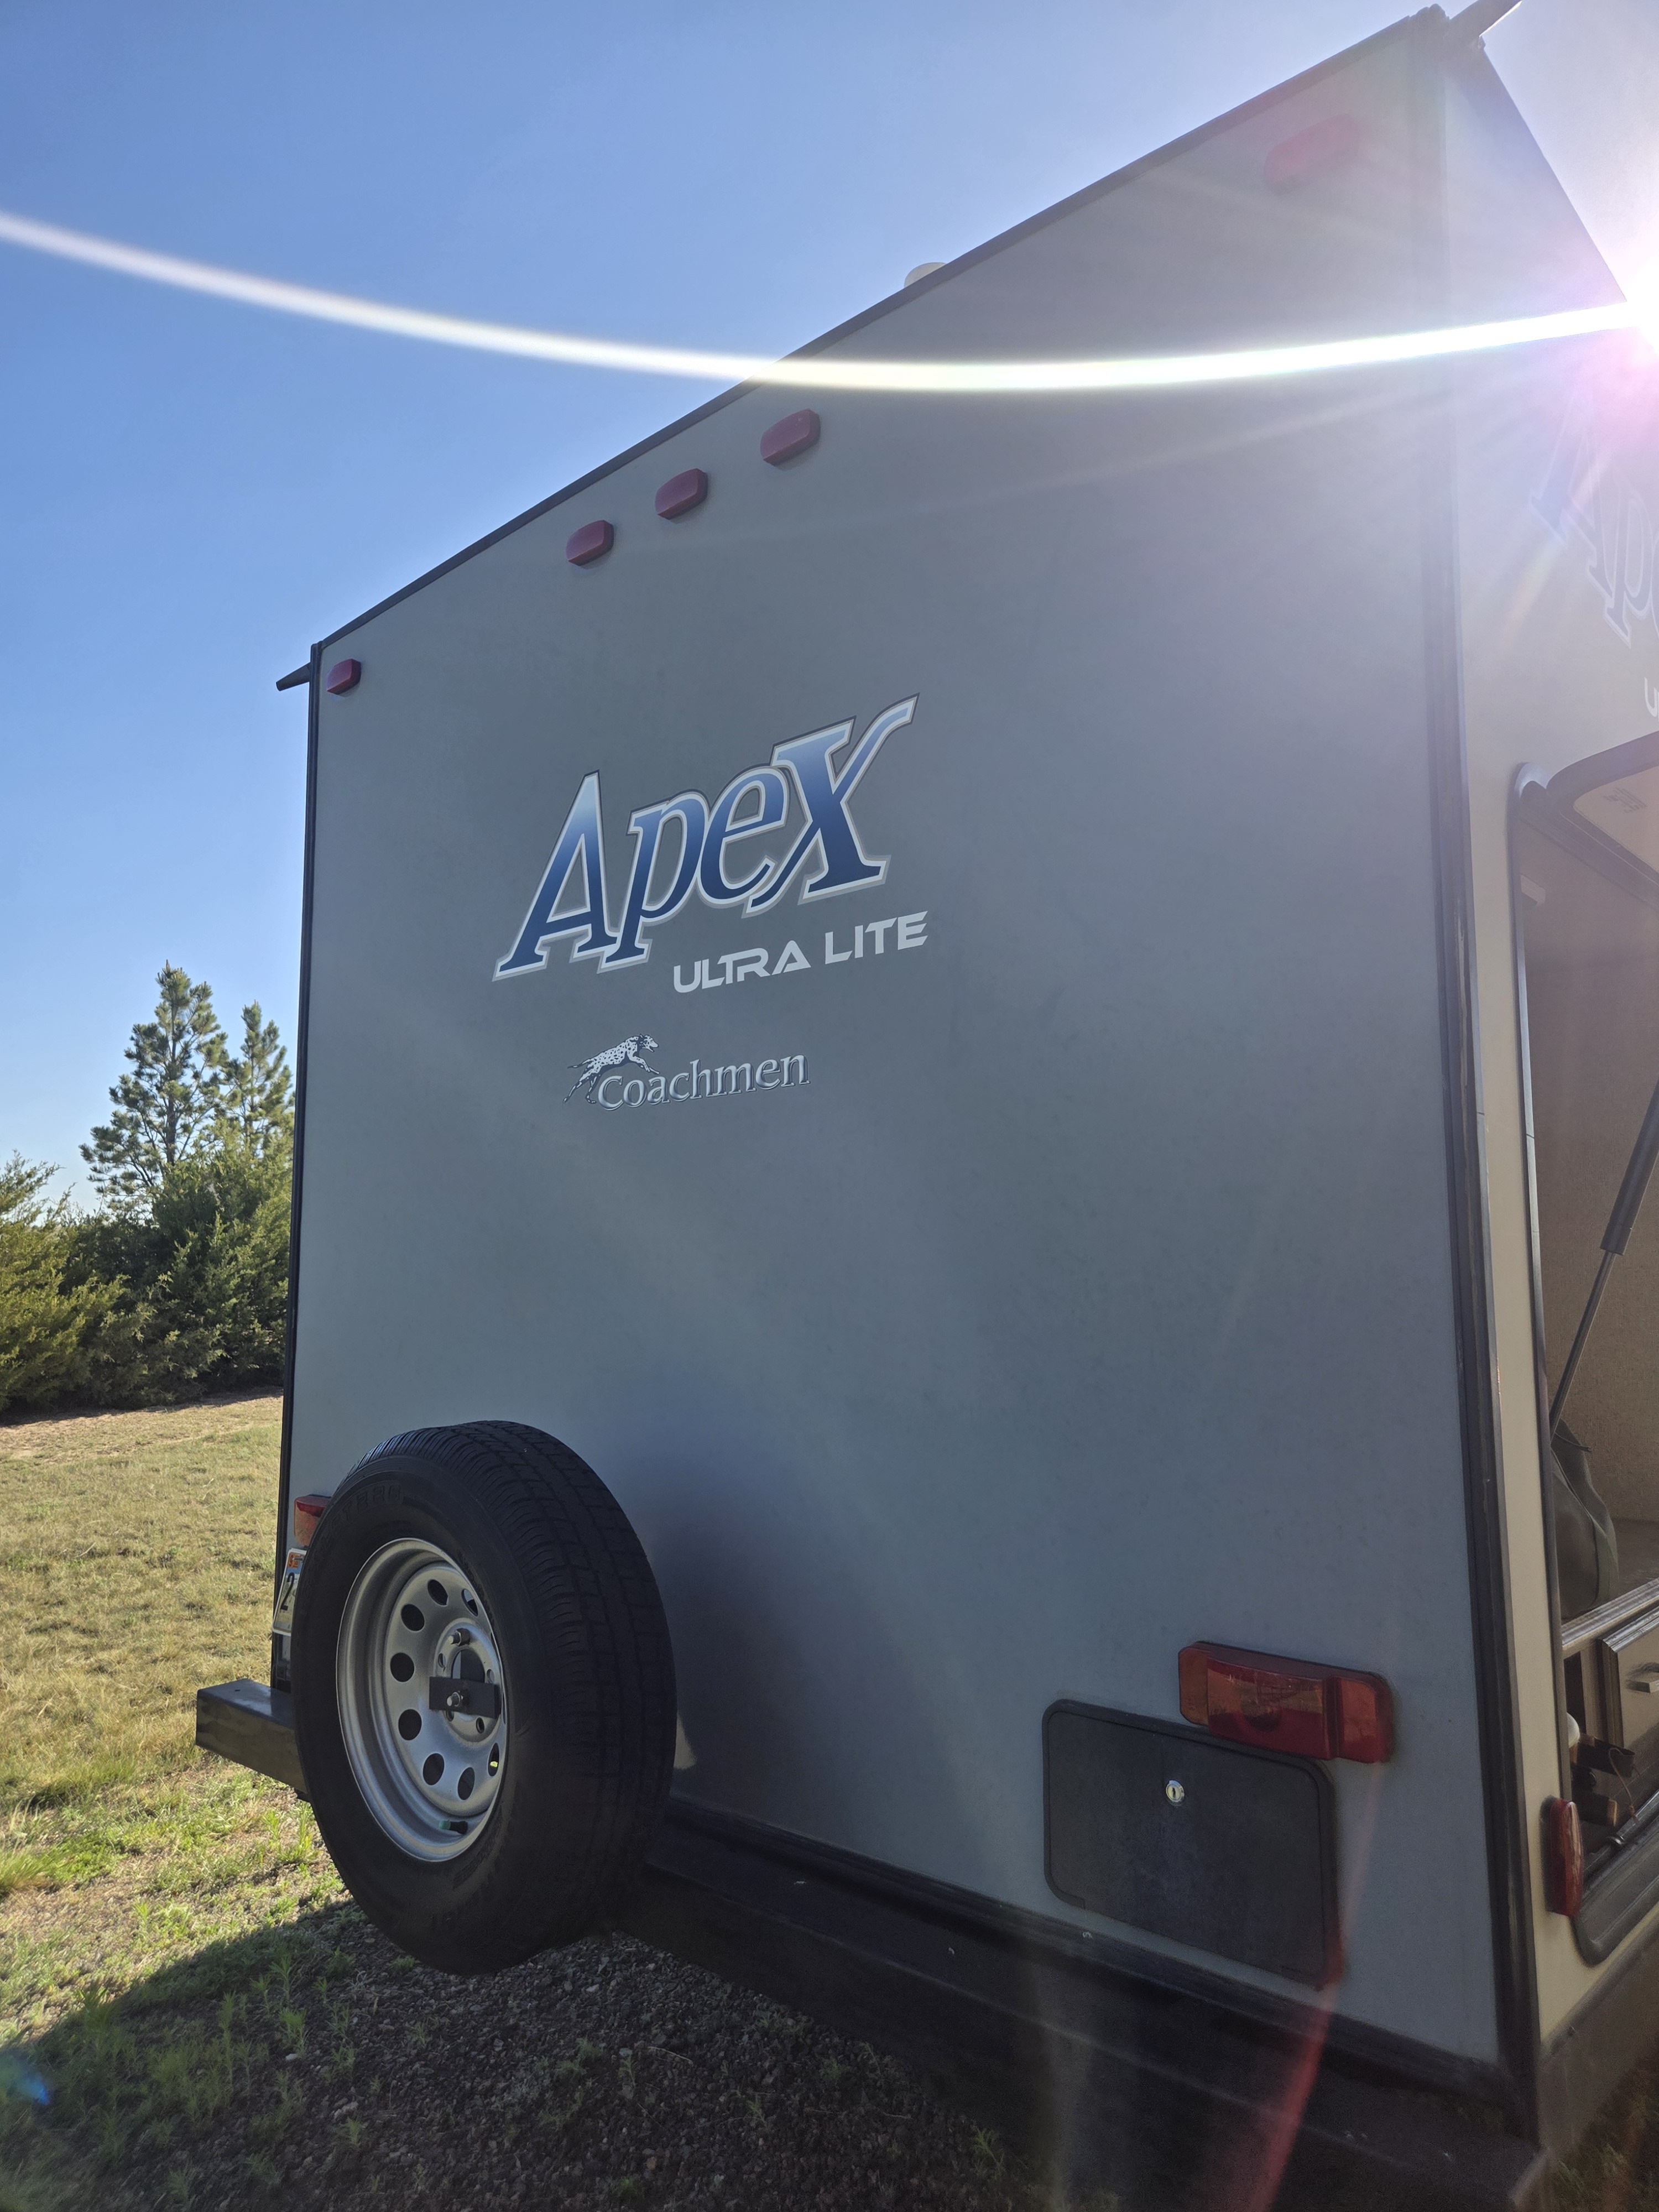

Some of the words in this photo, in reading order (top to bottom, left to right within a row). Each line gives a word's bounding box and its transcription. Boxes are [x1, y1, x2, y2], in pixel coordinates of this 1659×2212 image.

[673, 940, 812, 993] ULTRA
[825, 910, 928, 964] LITE
[597, 1053, 811, 1111] Coachmen
